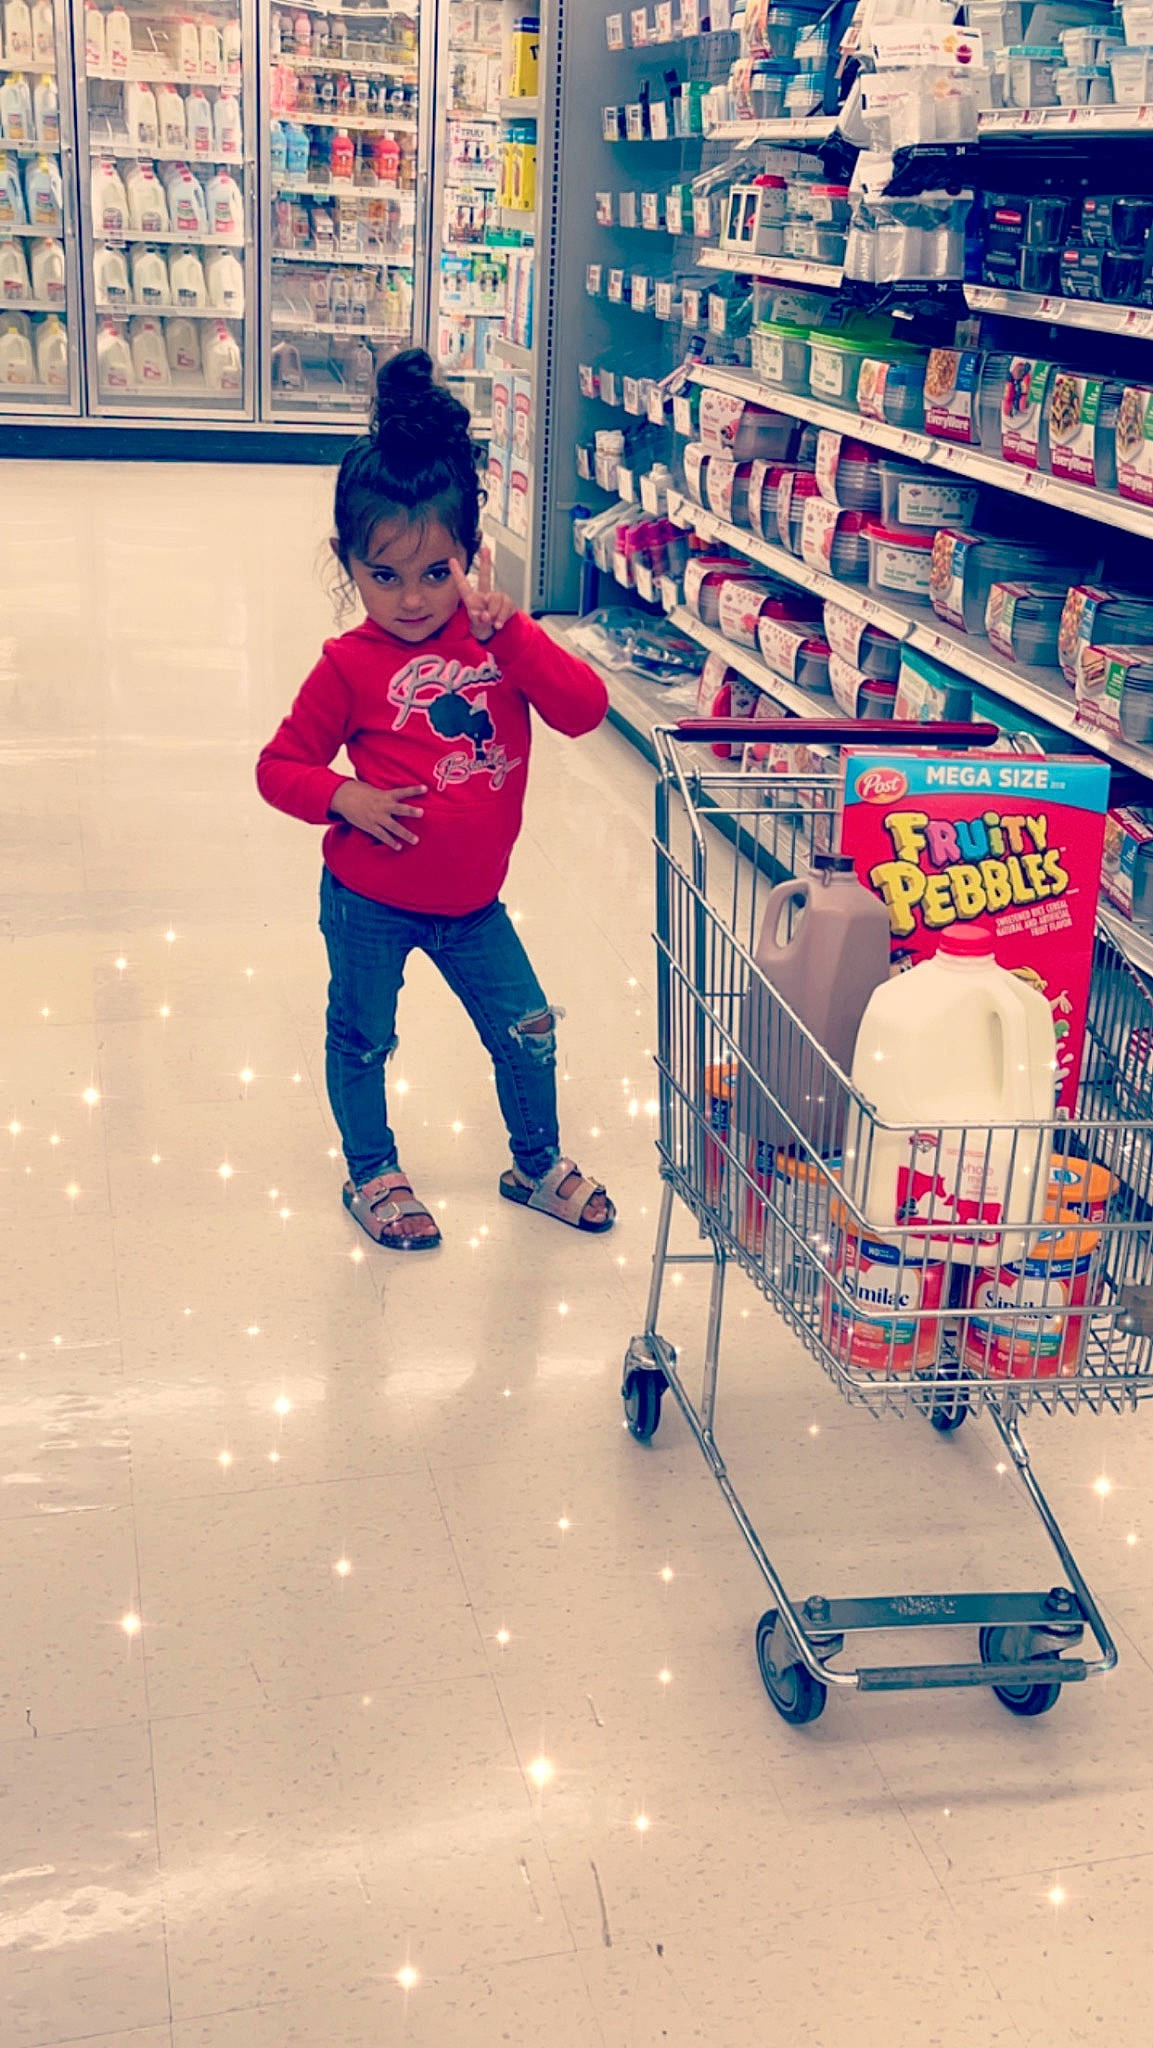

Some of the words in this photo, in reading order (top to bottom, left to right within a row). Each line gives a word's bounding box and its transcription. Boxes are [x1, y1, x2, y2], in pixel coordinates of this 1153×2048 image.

[387, 652, 502, 731] Black
[862, 773, 901, 795] Post
[926, 765, 992, 787] MEGA
[998, 767, 1049, 789] SIZE
[869, 849, 1069, 936] PEBBLES
[844, 1275, 910, 1307] Smilac
